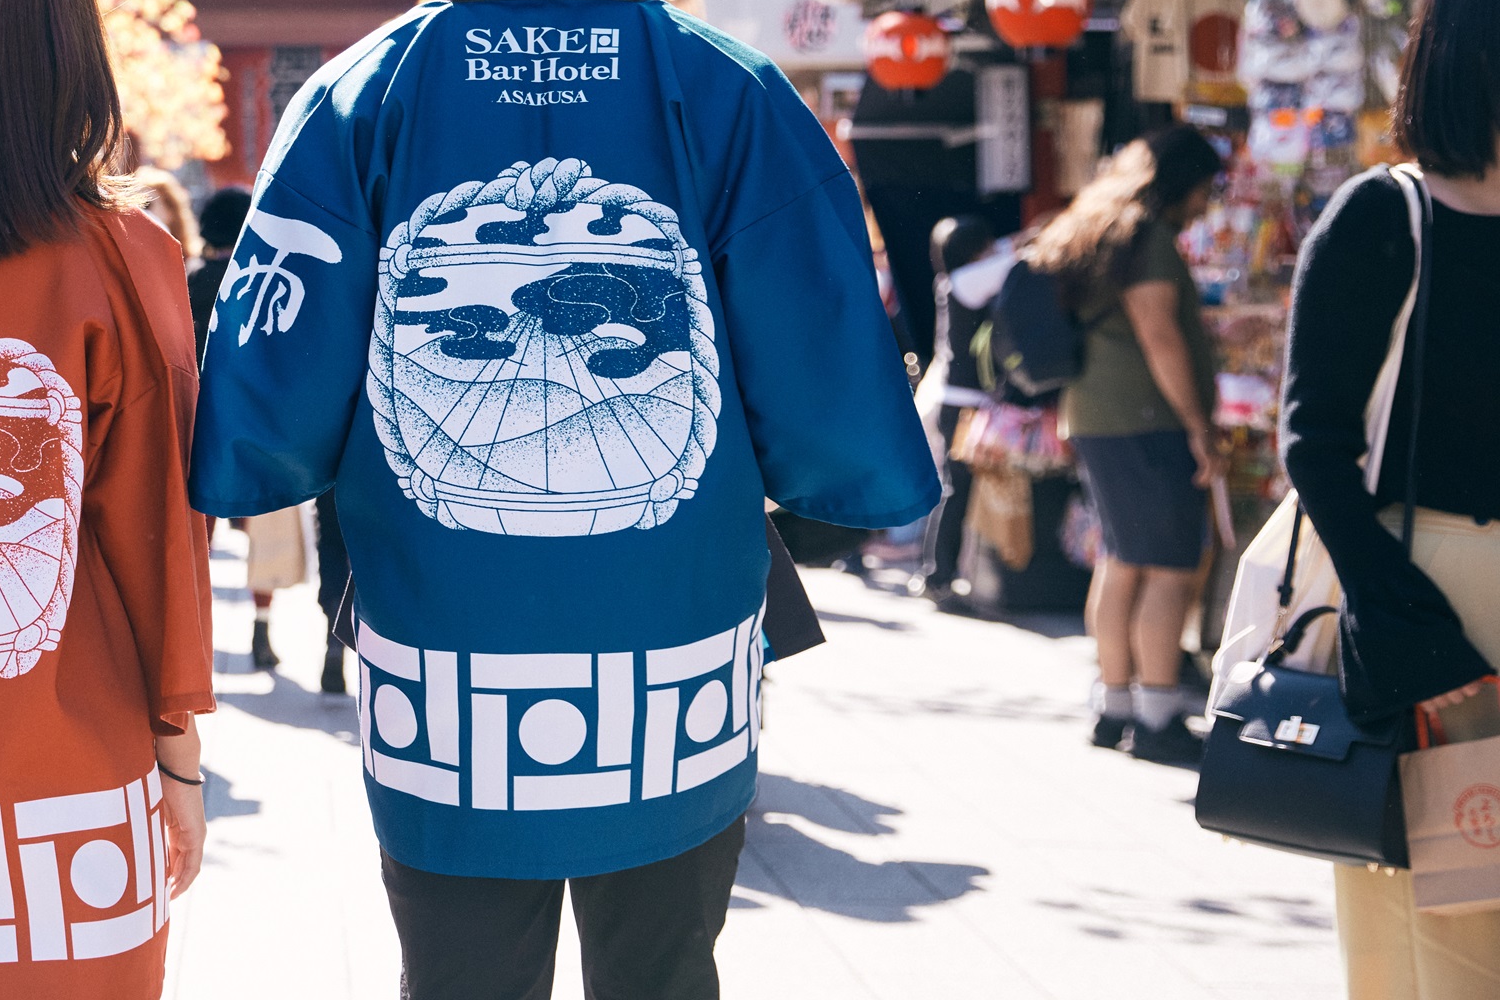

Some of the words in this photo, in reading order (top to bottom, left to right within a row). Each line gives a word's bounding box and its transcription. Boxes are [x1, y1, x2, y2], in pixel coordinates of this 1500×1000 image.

[464, 26, 588, 55] SAKE
[465, 58, 527, 81] Bar
[531, 57, 621, 83] Hotel
[496, 89, 589, 107] ASAKUSA
